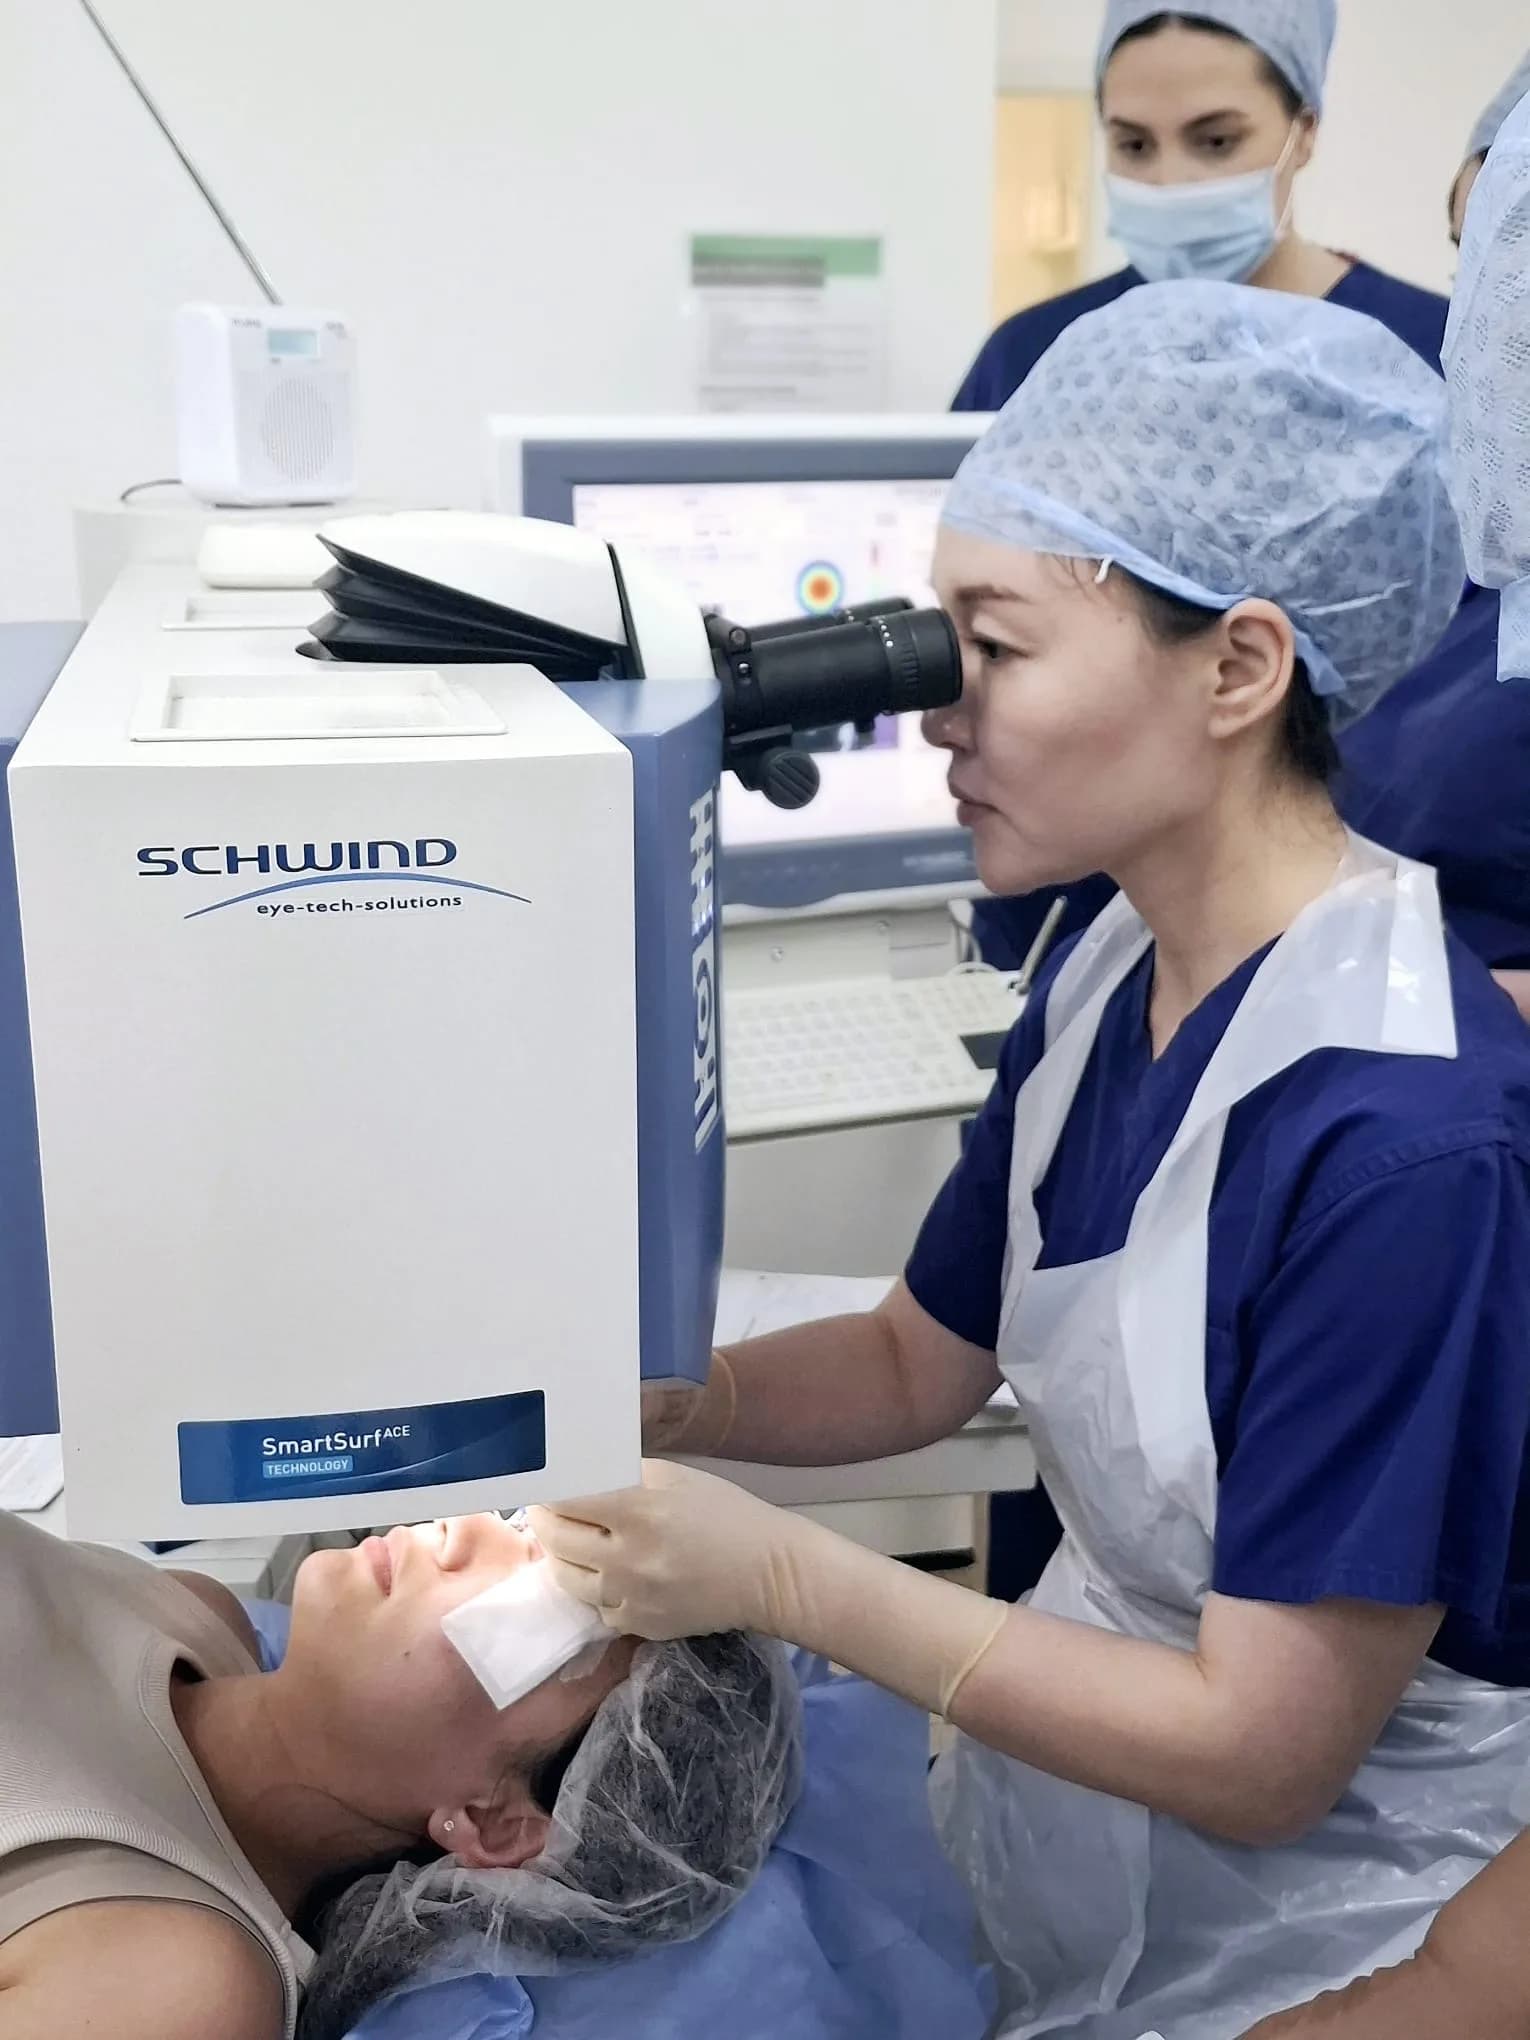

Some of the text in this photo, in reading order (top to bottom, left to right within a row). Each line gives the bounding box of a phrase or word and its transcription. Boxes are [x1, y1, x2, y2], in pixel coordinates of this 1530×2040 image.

[136, 838, 458, 877] SCHWIND
[256, 895, 463, 918] eye-tech-solutions
[266, 1458, 350, 1476] TECHNOLOGY
